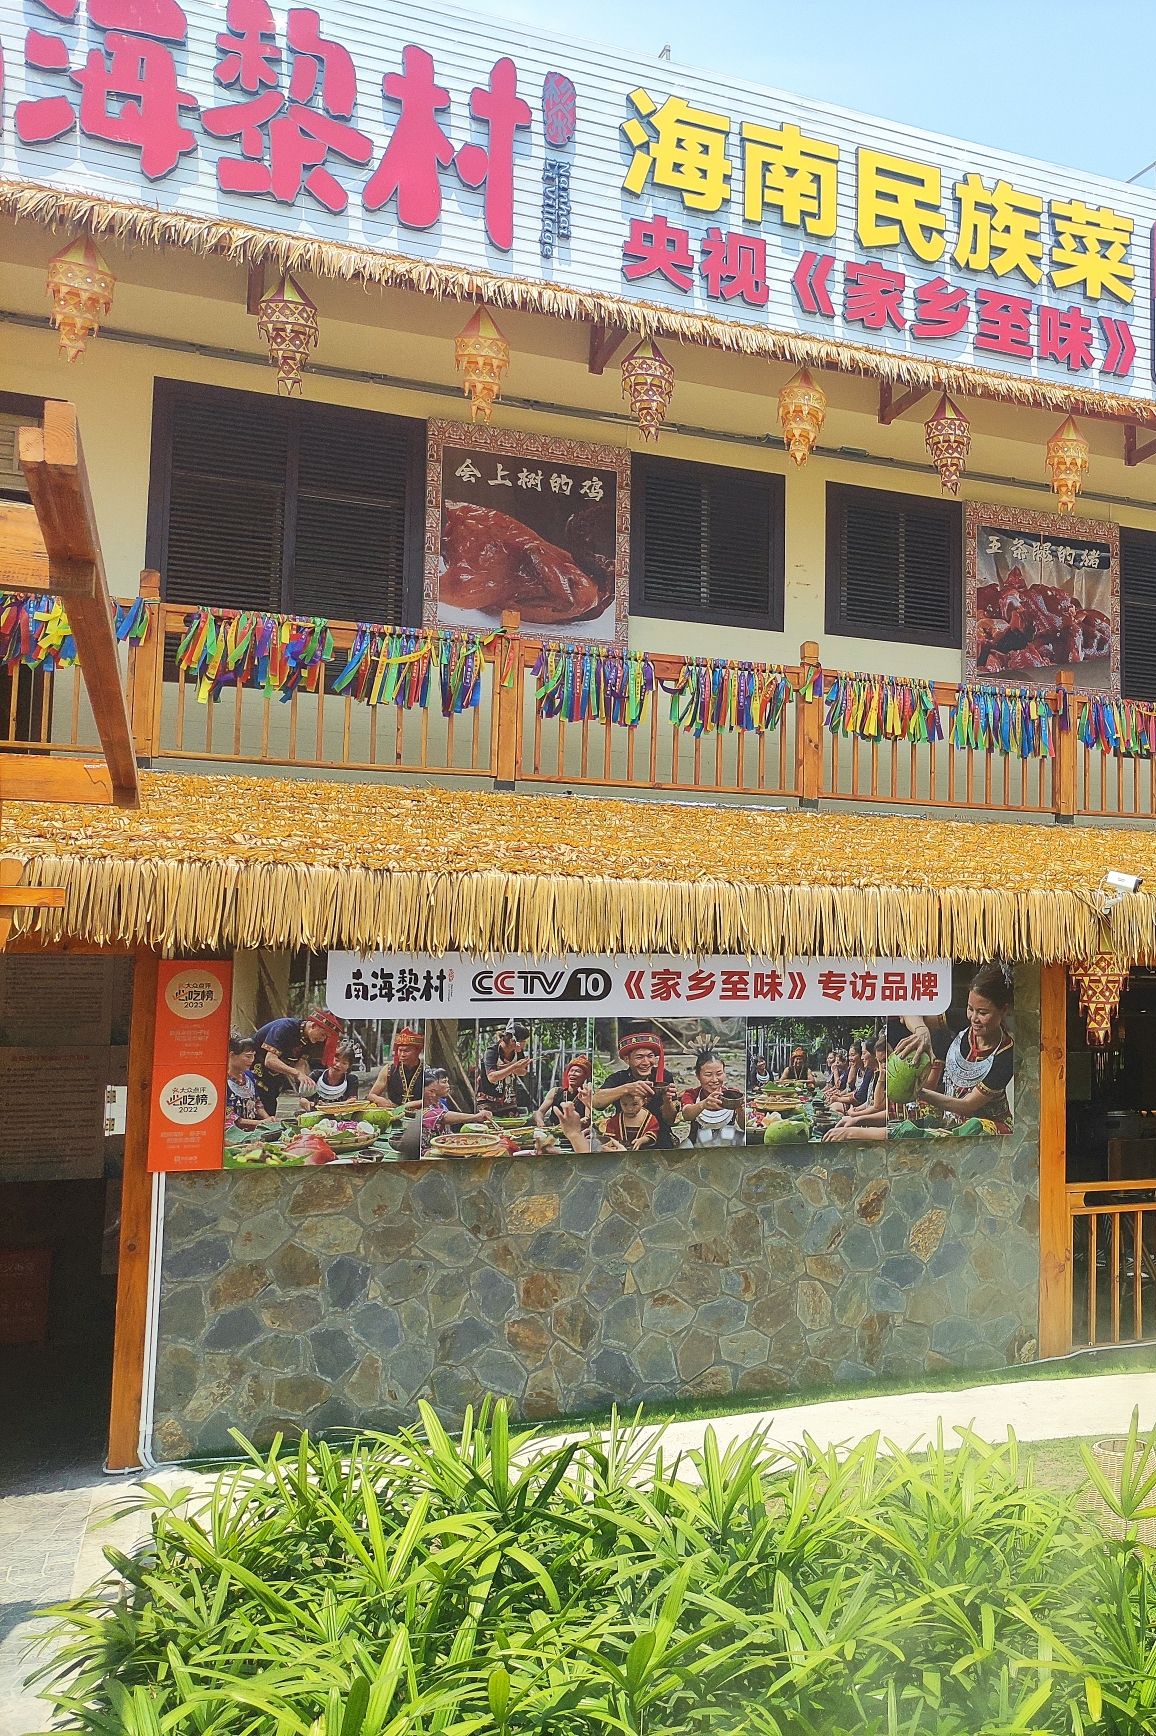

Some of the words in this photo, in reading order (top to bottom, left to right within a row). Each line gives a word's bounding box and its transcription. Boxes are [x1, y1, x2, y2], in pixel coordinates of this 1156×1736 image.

[0, 0, 532, 252] 海黎村
[557, 161, 571, 240] Nanhai
[619, 86, 1136, 303] 海南民族菜
[540, 186, 556, 259] Village
[455, 458, 604, 501] 会上树的鸡
[173, 989, 214, 1002] 必吃榜
[184, 1001, 204, 1009] 2023
[345, 968, 446, 1002] 南海黎村
[167, 1094, 209, 1106] 必吃榜
